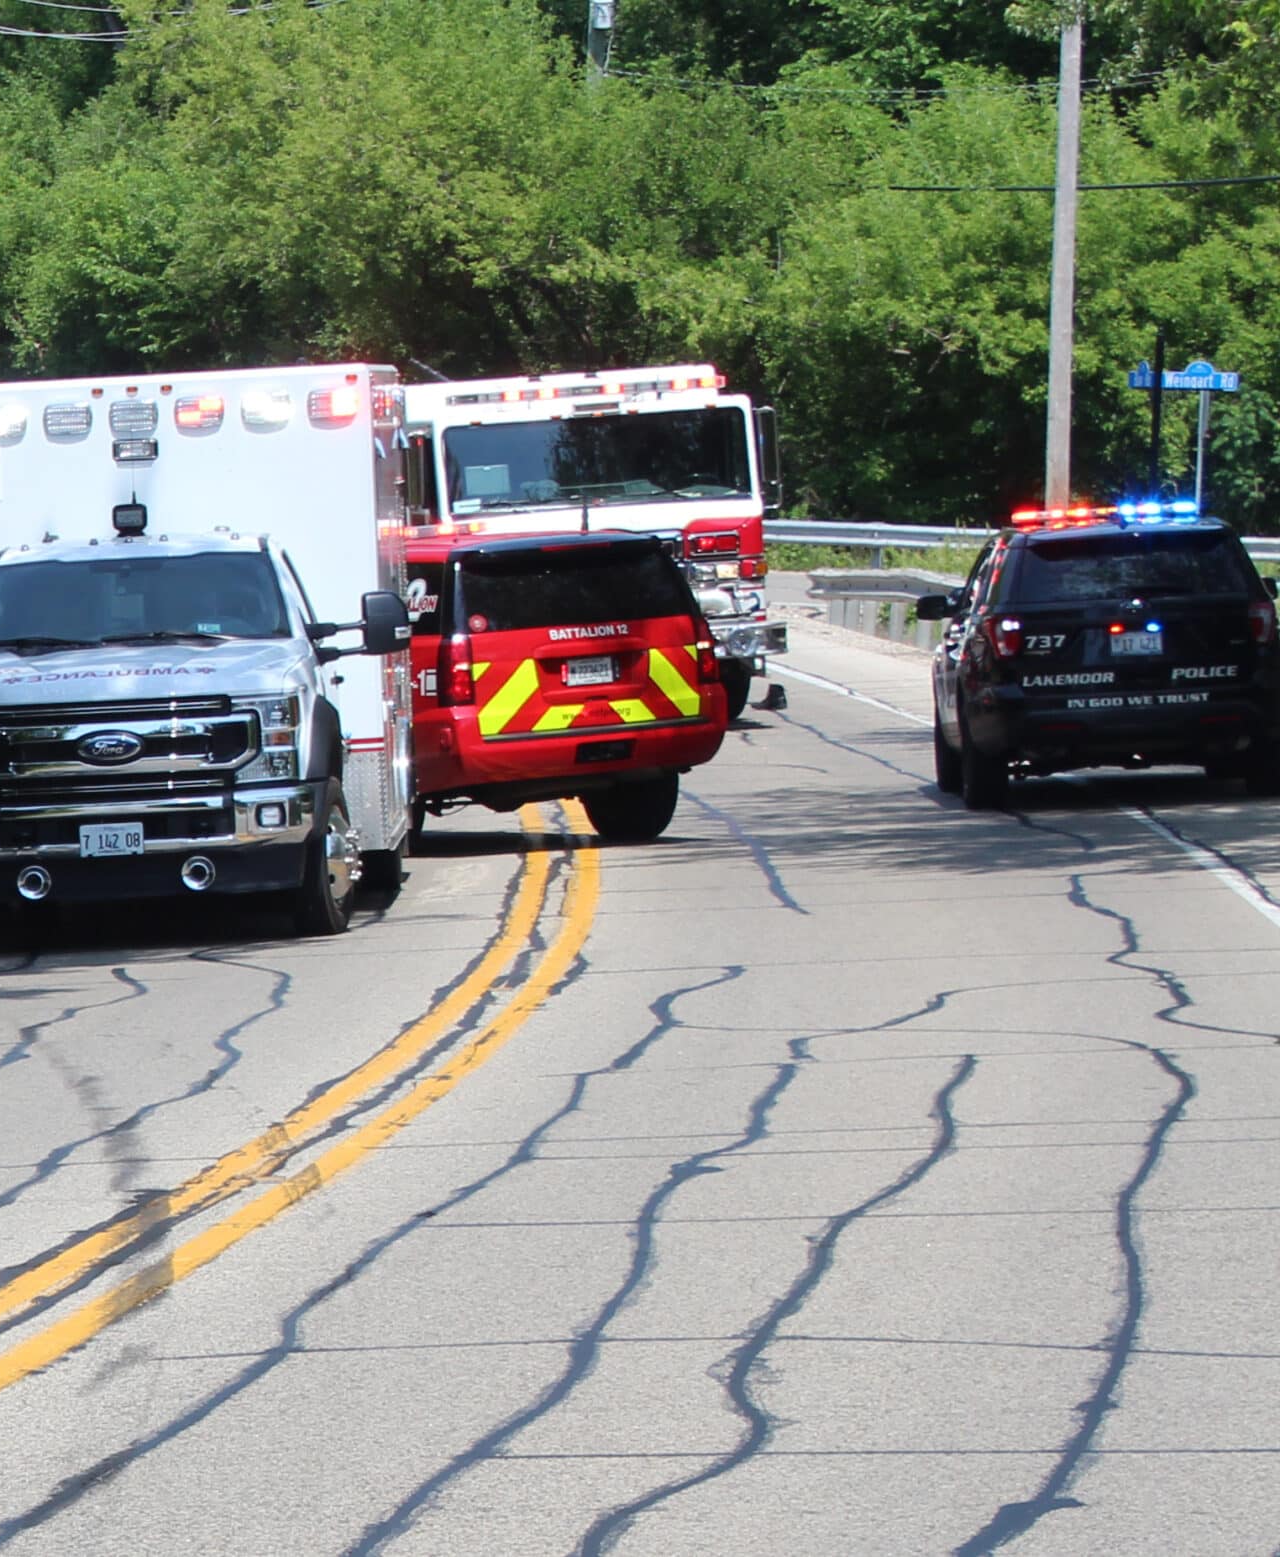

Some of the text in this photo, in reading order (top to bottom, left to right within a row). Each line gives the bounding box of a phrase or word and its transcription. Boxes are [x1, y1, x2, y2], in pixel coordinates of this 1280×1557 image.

[1165, 372, 1214, 389] Weingart
[1221, 373, 1237, 389] Rd
[549, 624, 628, 640] BATTALION 12
[1025, 635, 1066, 649] 737
[1022, 672, 1115, 687] LAKEMOOR
[1172, 666, 1238, 679] POLICE
[1067, 693, 1209, 708] IN GOD WE TRUST
[93, 740, 126, 755] Ford
[82, 835, 90, 850] 7
[98, 833, 120, 849] 142
